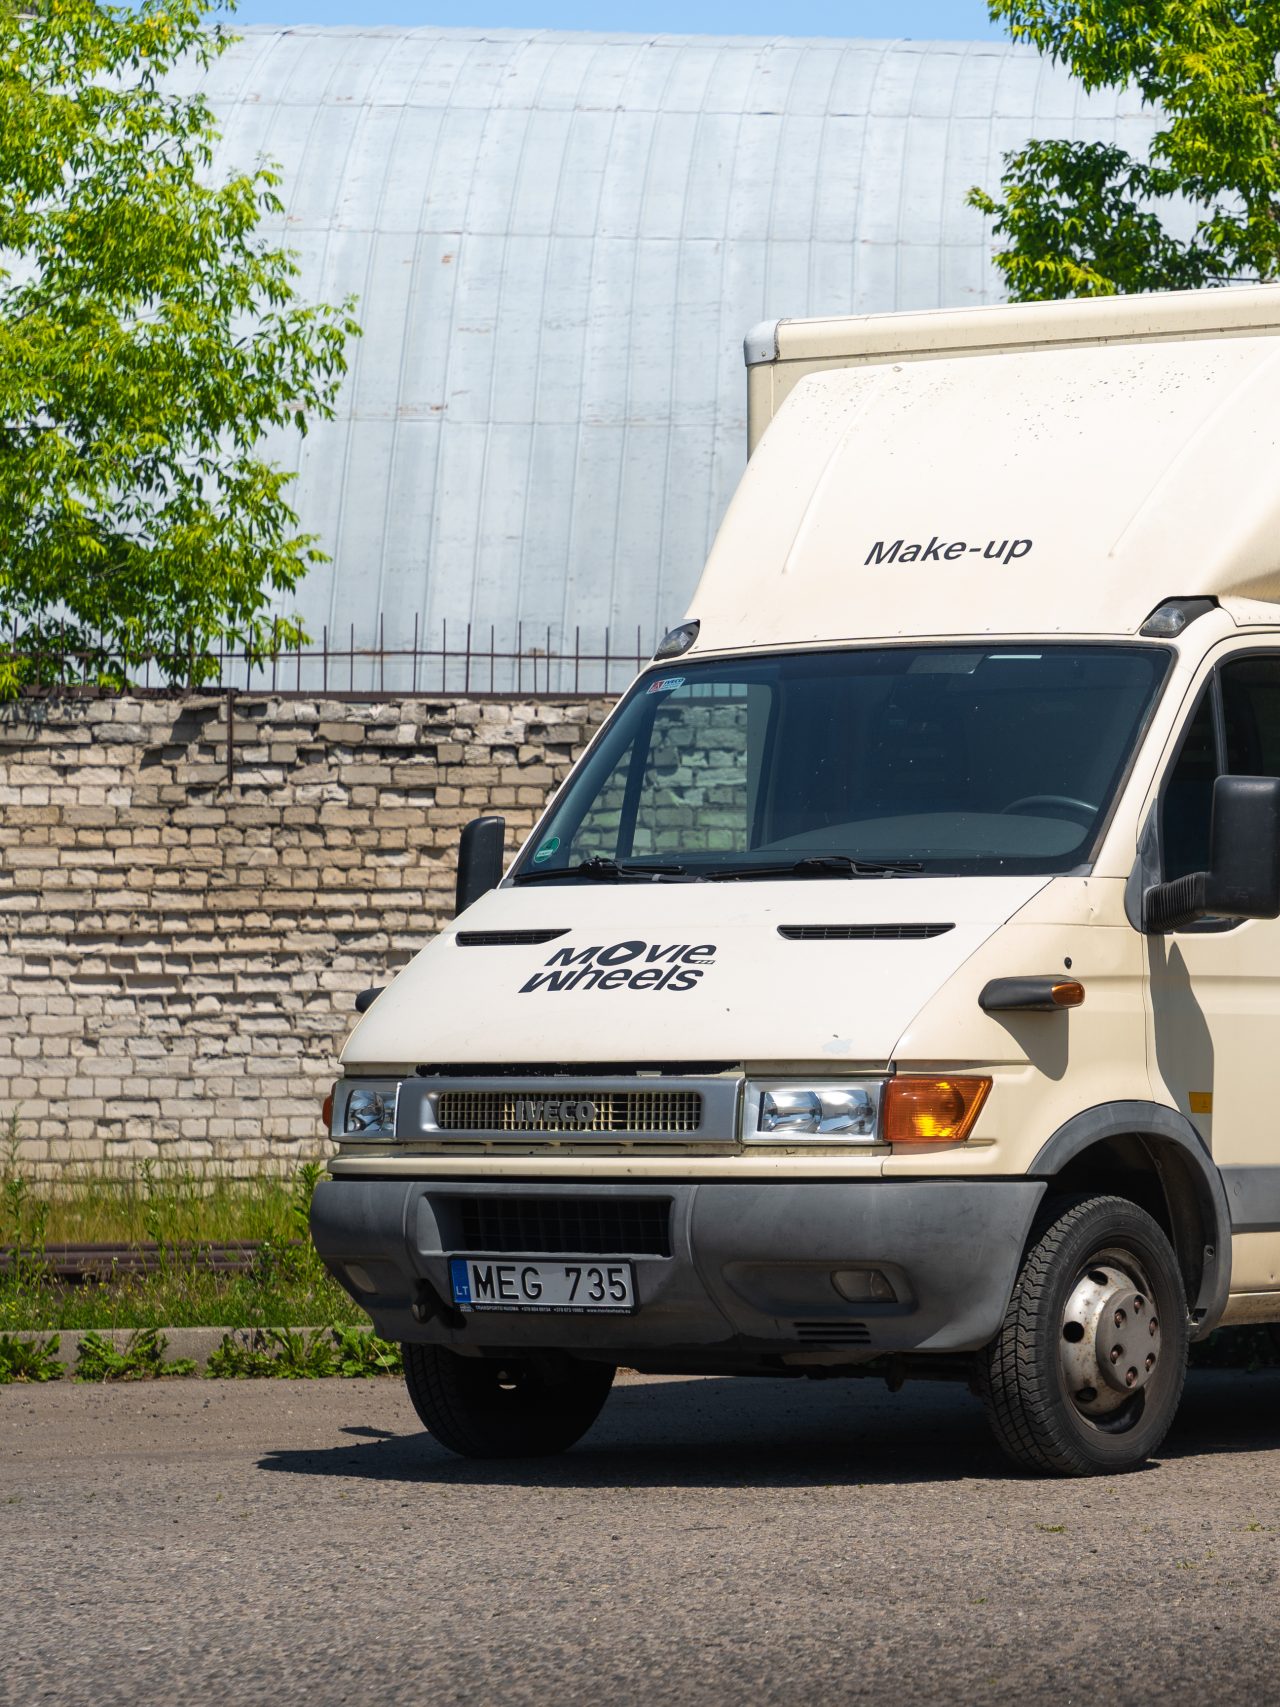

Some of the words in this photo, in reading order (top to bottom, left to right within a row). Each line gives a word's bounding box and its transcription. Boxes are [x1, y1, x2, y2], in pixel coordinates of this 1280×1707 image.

[863, 536, 1033, 565] Make-up
[515, 1101, 596, 1122] IVECO
[456, 1286, 468, 1296] LT
[472, 1264, 543, 1300] MEG
[565, 1267, 627, 1301] 735
